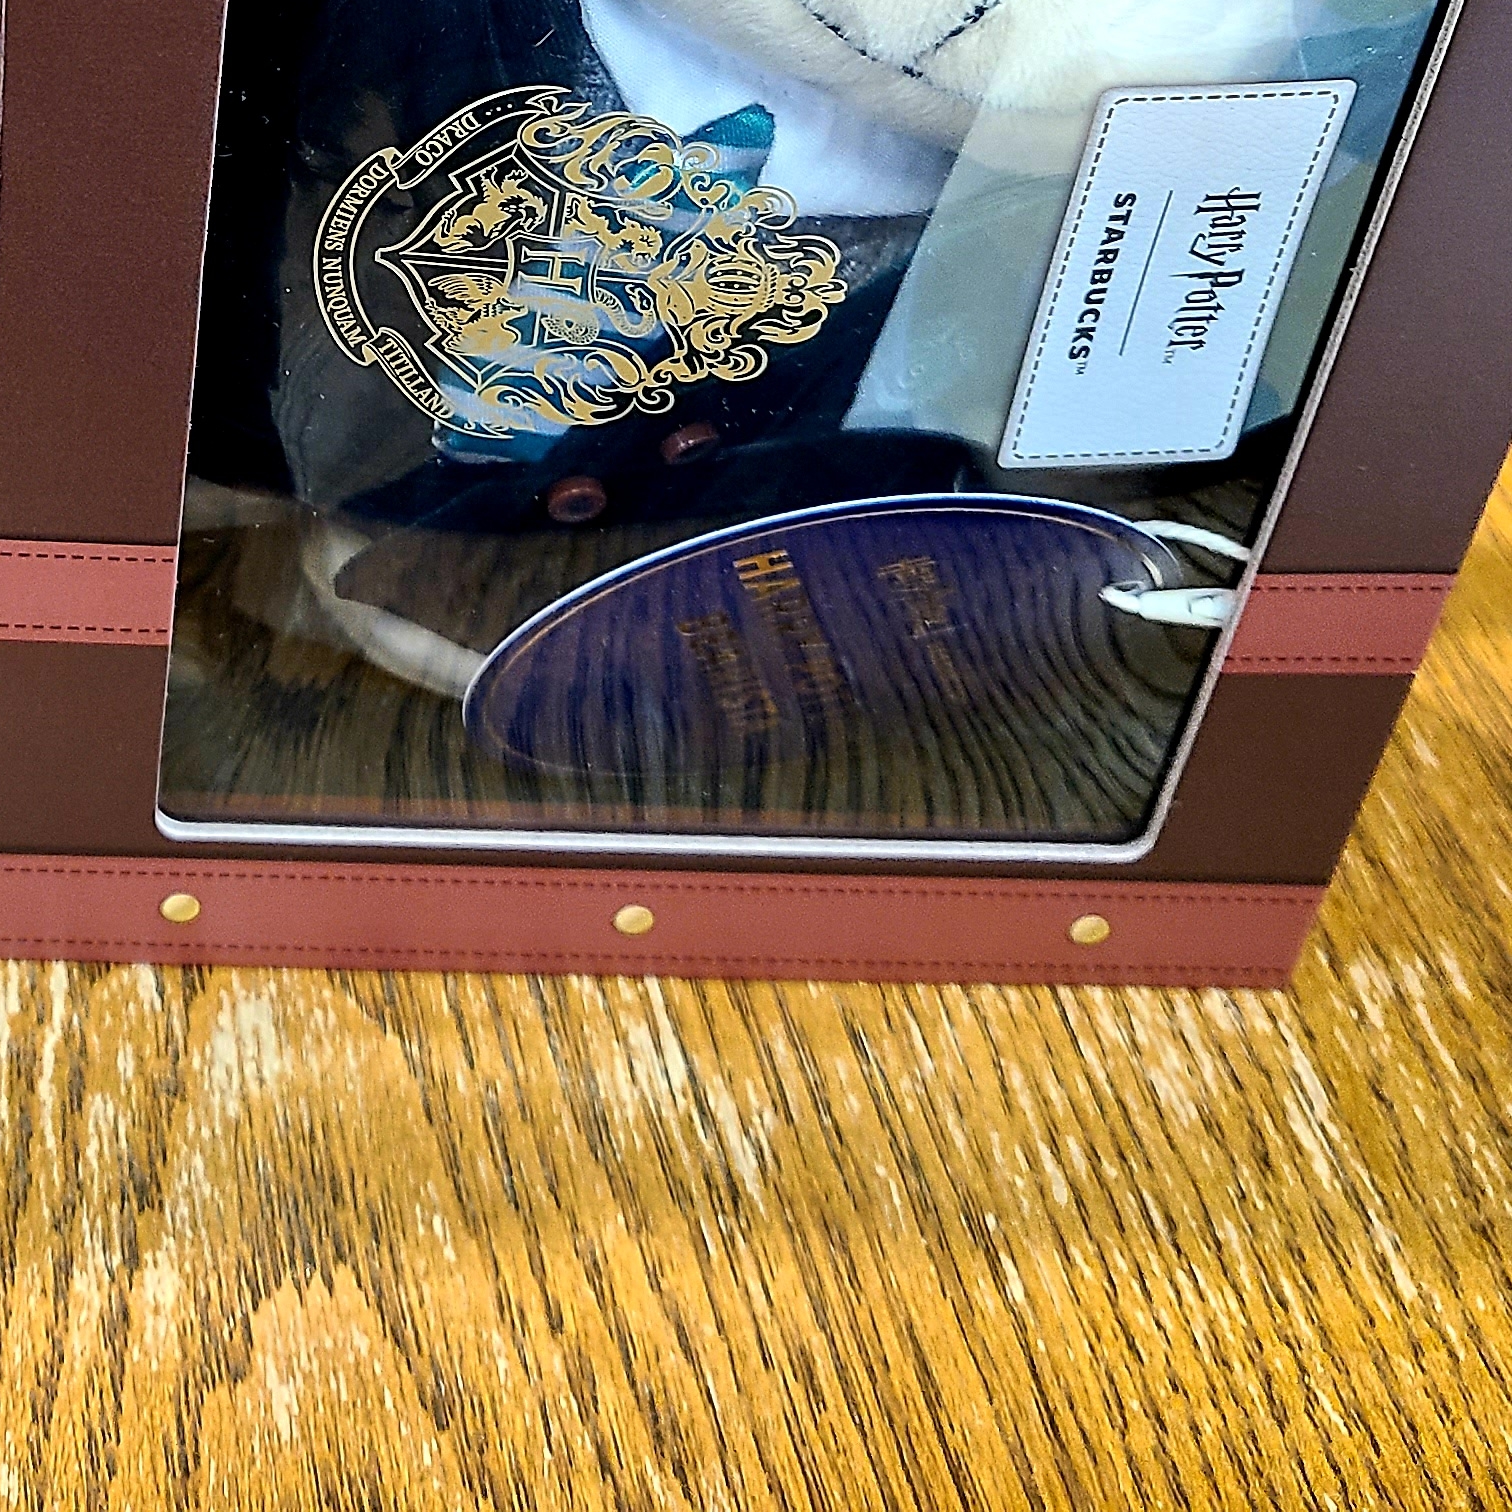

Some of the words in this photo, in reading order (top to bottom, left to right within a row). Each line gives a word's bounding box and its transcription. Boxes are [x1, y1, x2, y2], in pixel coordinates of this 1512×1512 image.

[415, 112, 482, 166] DRACO
[324, 163, 389, 252] DORMIENS
[1188, 187, 1262, 266] Harry
[322, 256, 367, 348] NUNQUAM
[1066, 192, 1137, 360] STARBUCKS
[1168, 268, 1245, 351] Potter
